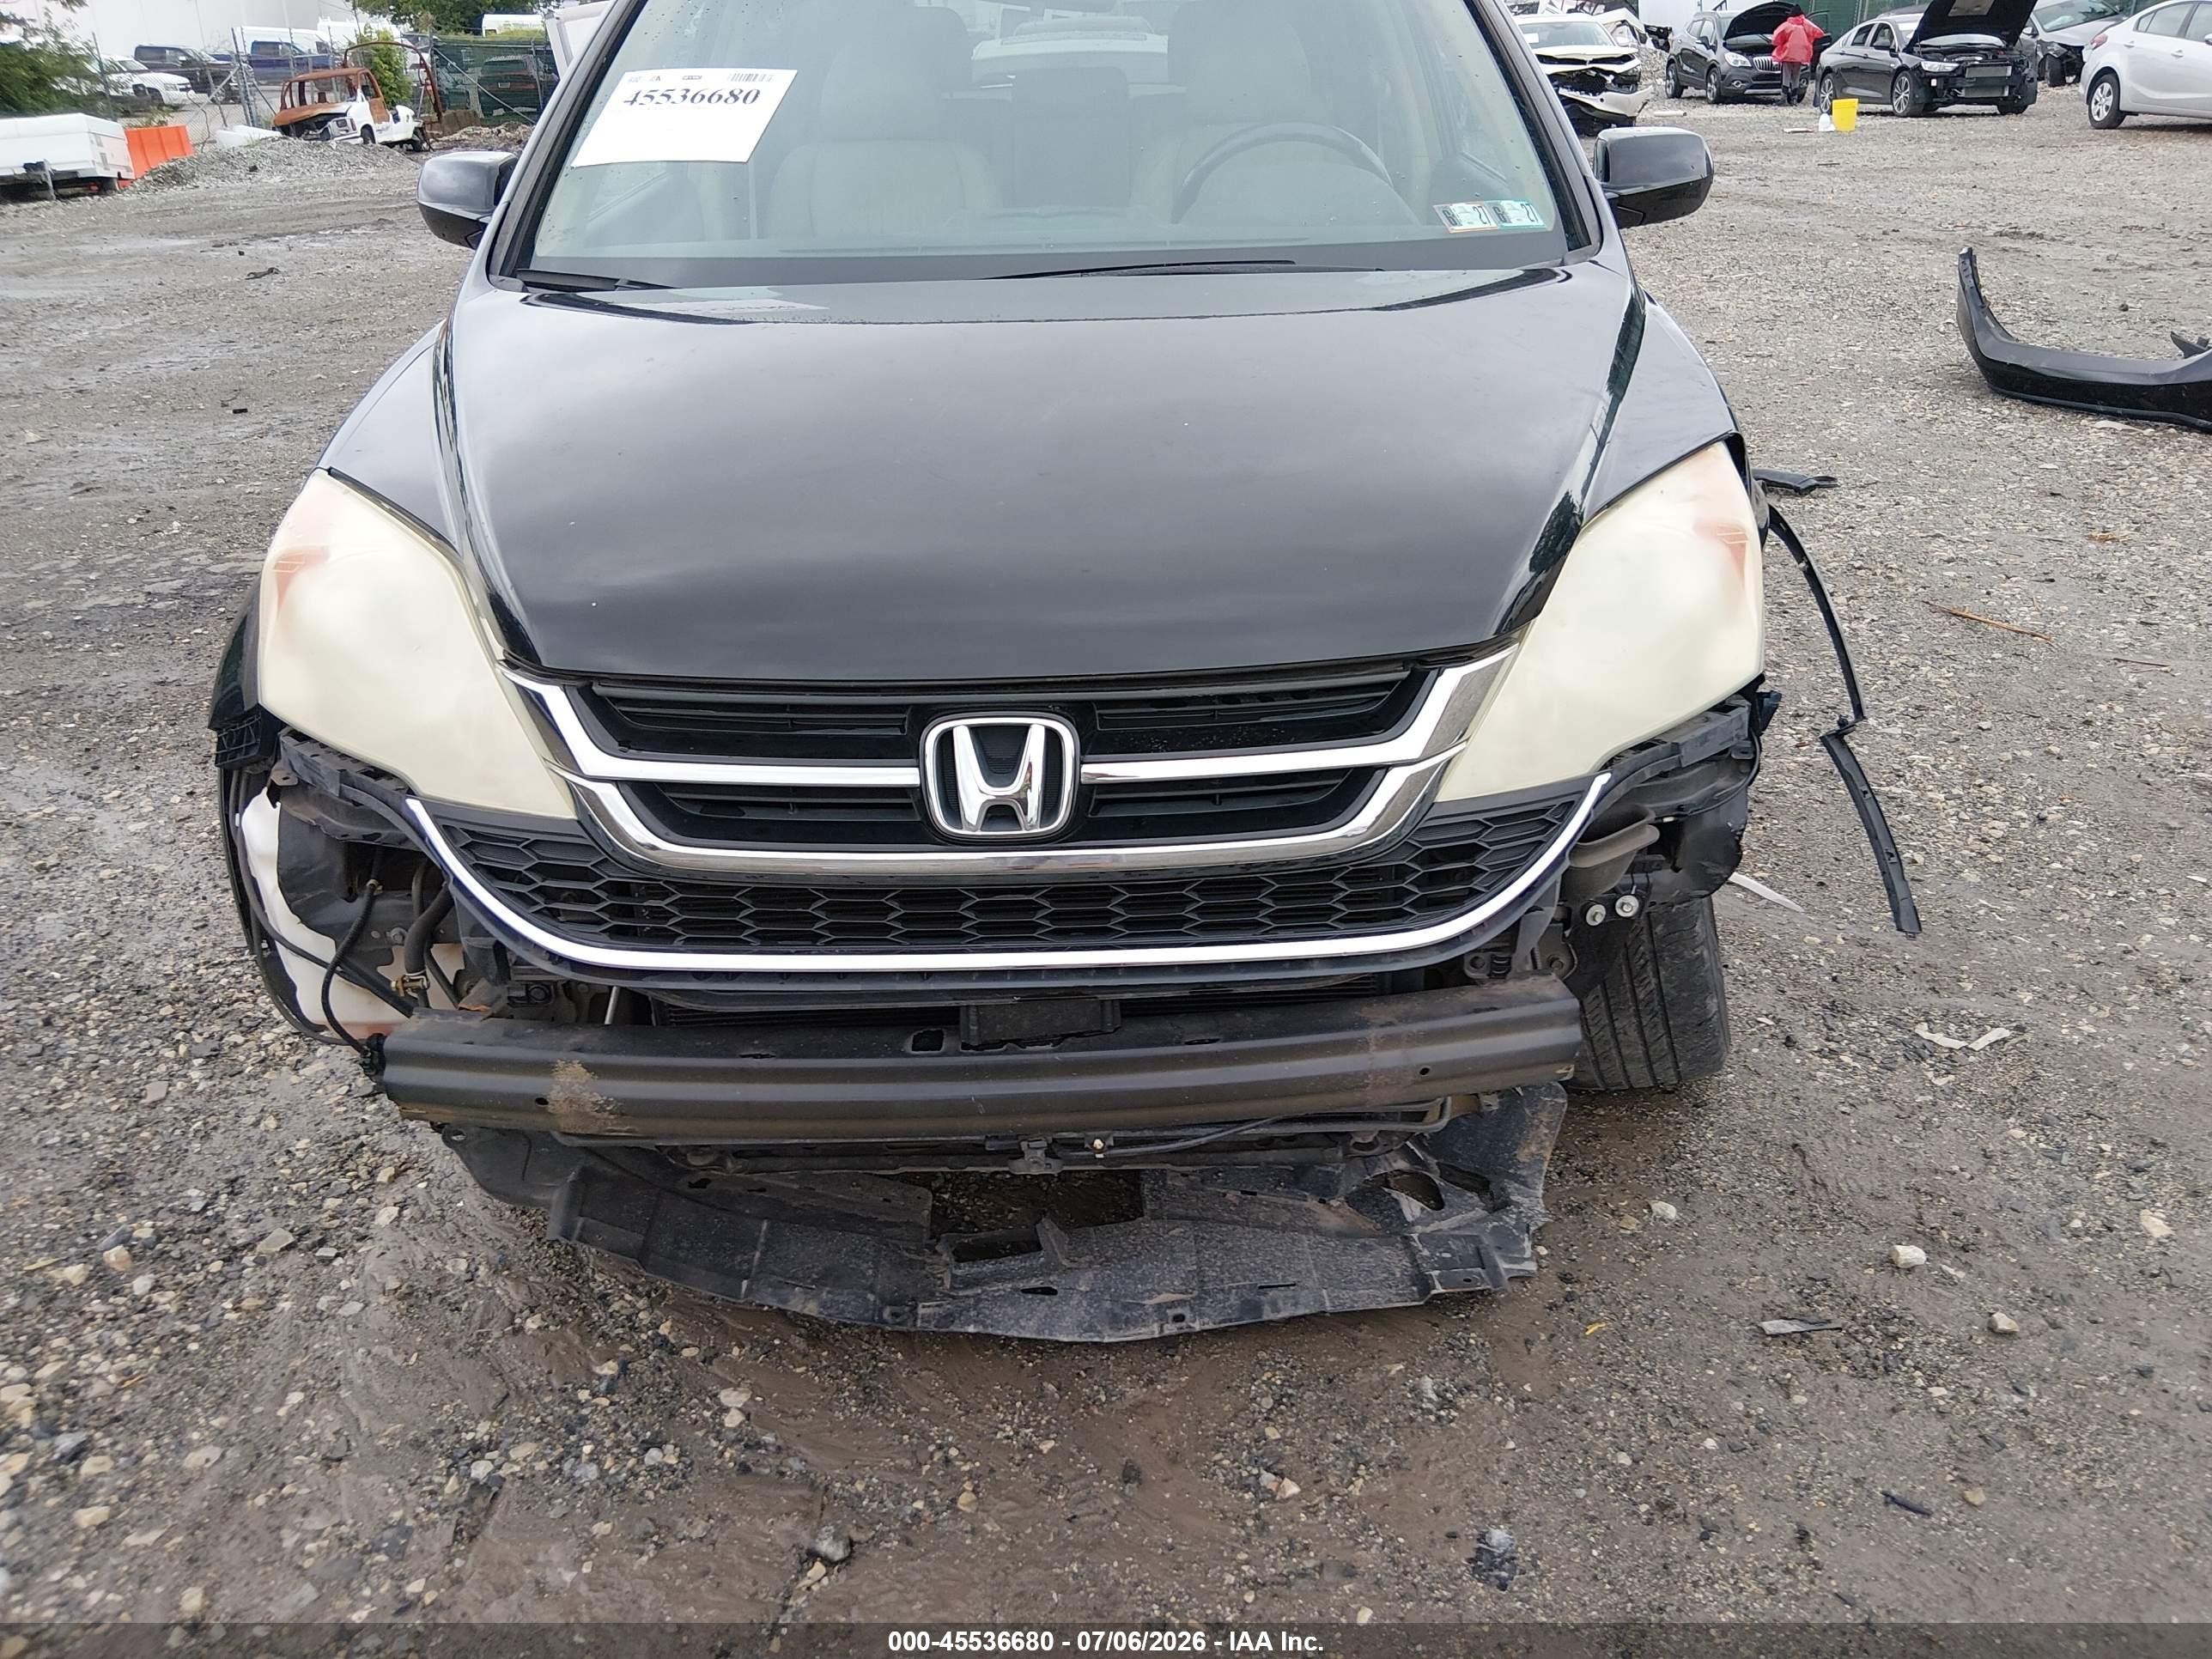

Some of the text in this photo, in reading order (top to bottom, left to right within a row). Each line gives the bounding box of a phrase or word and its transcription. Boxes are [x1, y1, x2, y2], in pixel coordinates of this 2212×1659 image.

[623, 88, 760, 106] 45536680
[1473, 205, 1492, 226] 27
[1521, 203, 1539, 223] 27
